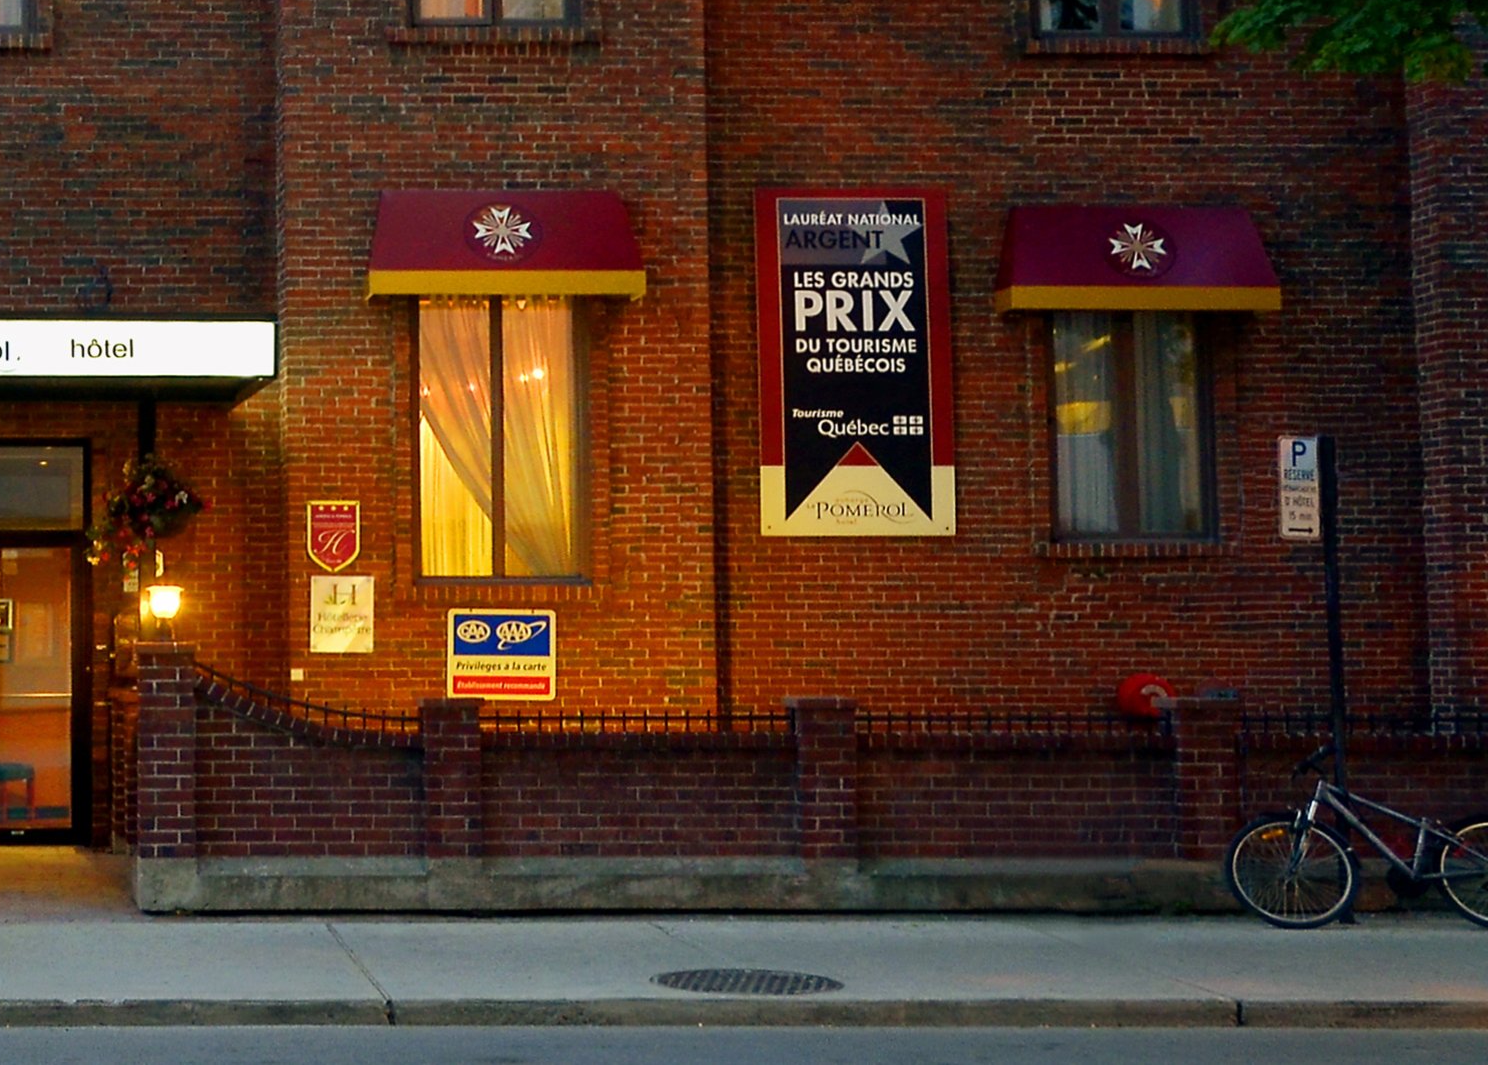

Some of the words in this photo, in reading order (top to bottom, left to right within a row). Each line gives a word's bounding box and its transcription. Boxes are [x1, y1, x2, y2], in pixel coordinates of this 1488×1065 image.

[783, 211, 843, 226] LAURÉAT
[847, 213, 921, 226] NATIONAL
[785, 229, 885, 250] ARGENT
[793, 271, 825, 288] LES
[831, 271, 915, 288] GRANDS
[794, 289, 916, 332] PRIX
[70, 338, 134, 358] hôtel
[795, 338, 821, 354] DU
[826, 337, 918, 354] TOURISME
[806, 354, 907, 373] QUÉBÉCOIS
[791, 408, 845, 419] Tourisme
[817, 418, 890, 438] Québec
[1292, 441, 1307, 467] P
[459, 622, 489, 641] CAA
[498, 622, 530, 641] AAA
[512, 662, 521, 671] la
[523, 663, 547, 671] carte
